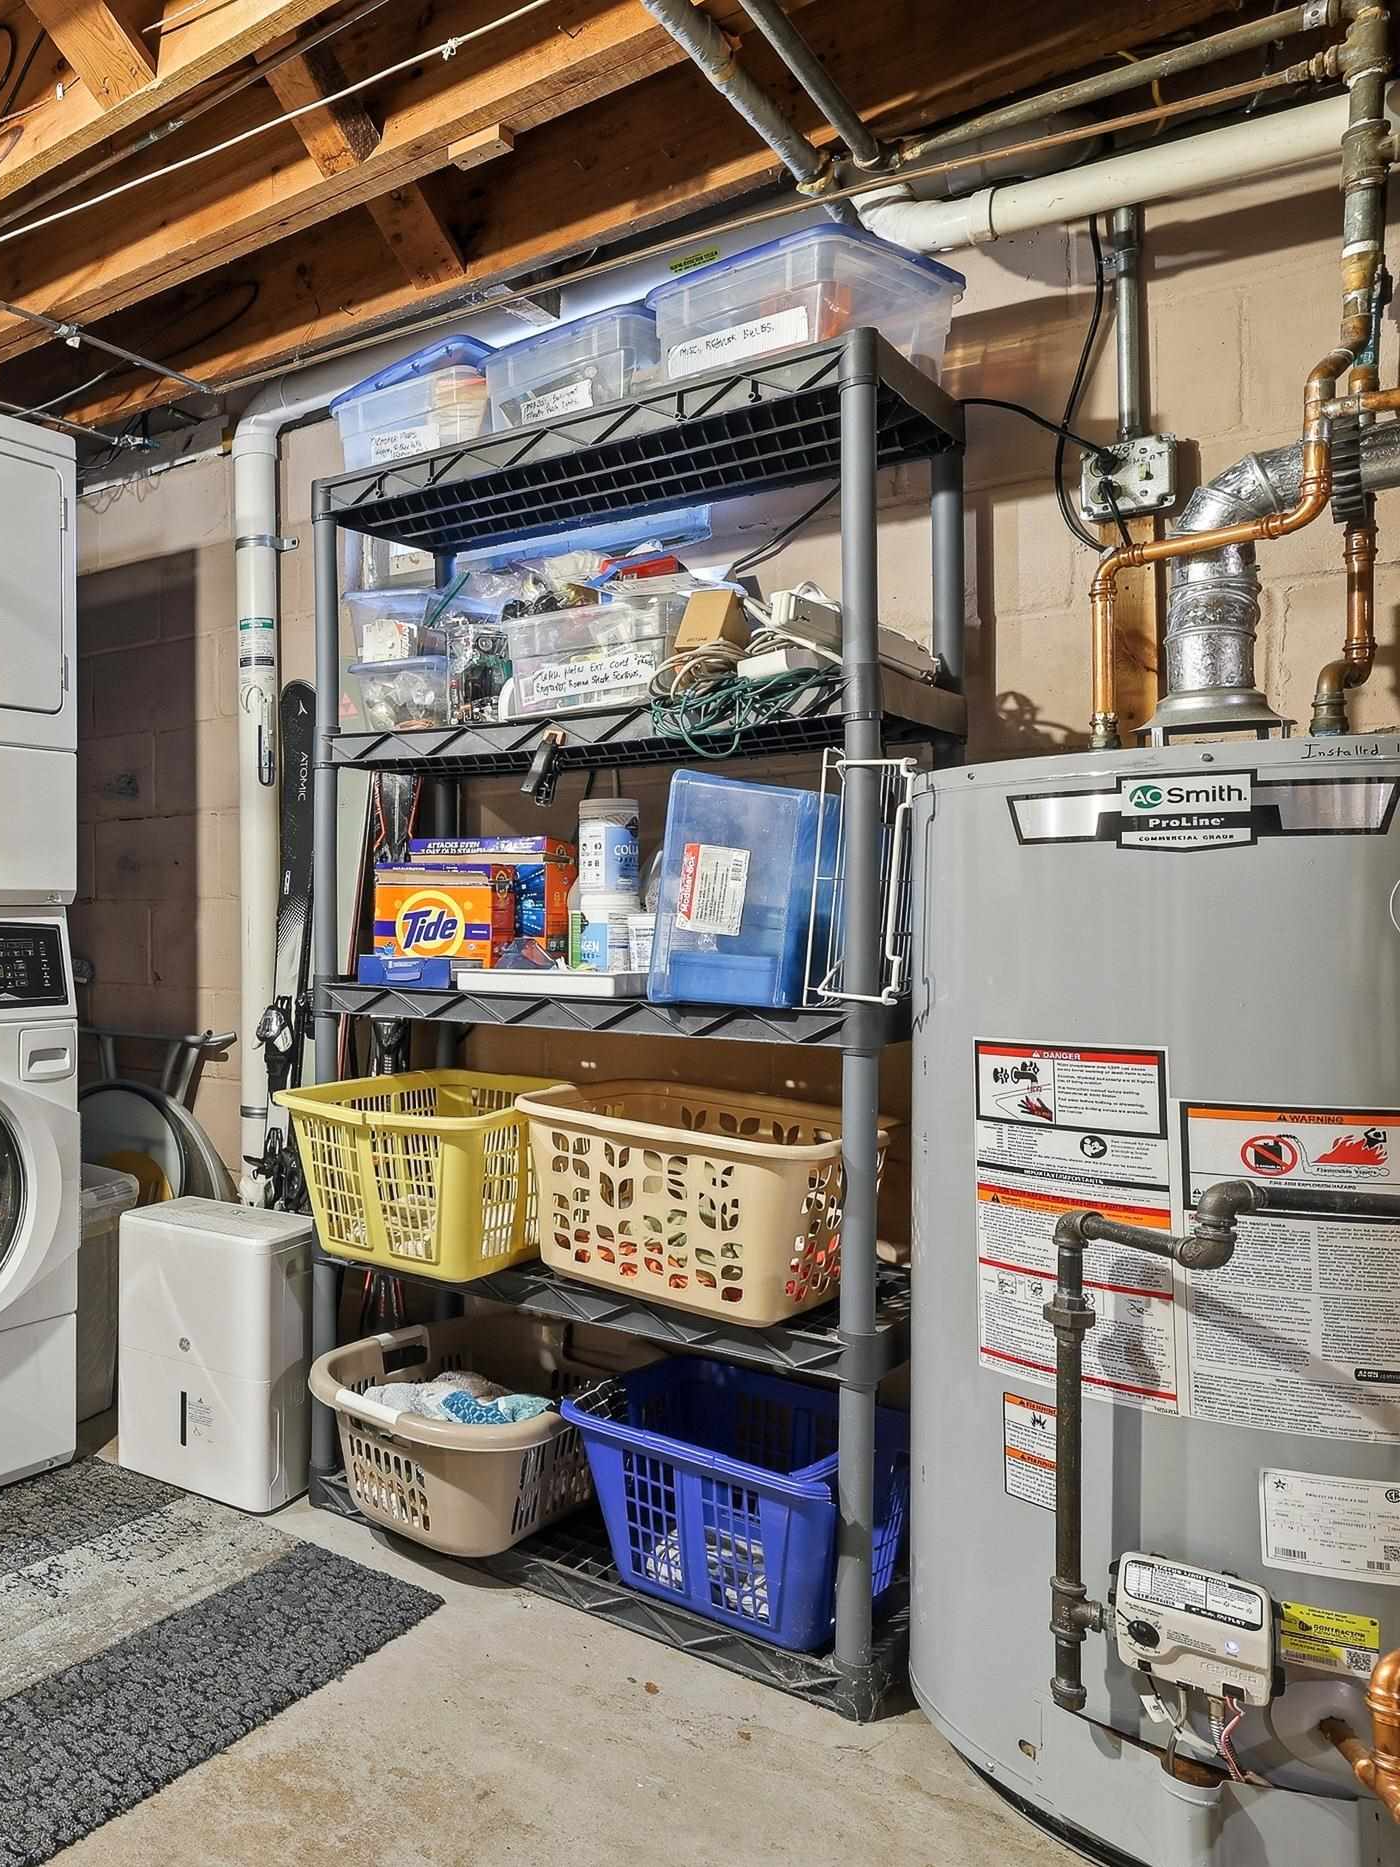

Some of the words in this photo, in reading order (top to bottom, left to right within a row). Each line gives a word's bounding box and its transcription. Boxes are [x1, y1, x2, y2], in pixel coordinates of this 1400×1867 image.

[297, 751, 309, 801] ATOMIC
[402, 908, 459, 950] Tide
[1043, 1052, 1081, 1061] DANGER
[1289, 1115, 1344, 1125] WARNING
